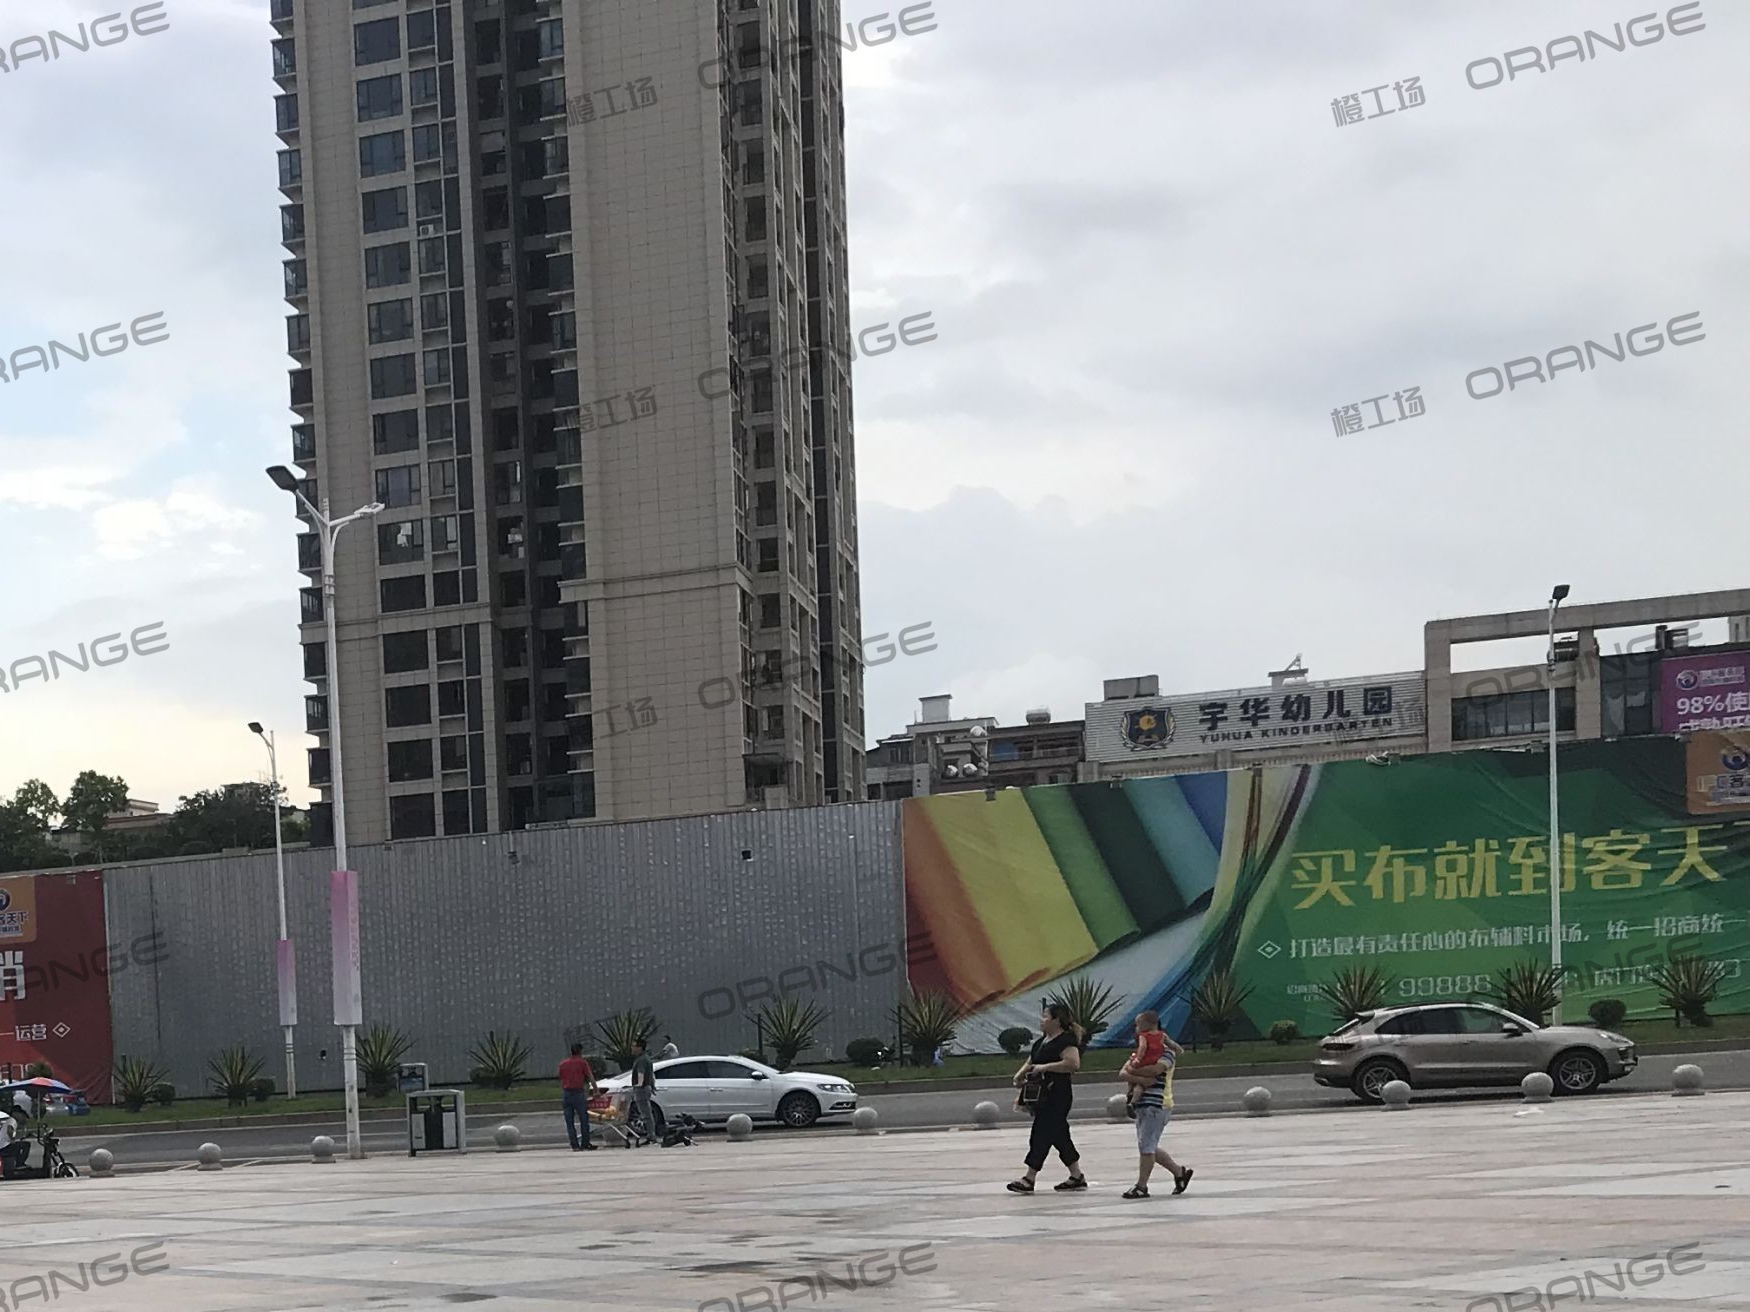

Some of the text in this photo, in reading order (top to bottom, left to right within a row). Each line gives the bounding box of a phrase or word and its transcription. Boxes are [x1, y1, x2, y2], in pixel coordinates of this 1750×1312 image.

[1199, 685, 1392, 731] 宇华幼儿园
[1200, 717, 1393, 744] YUHUA KINDERGARTEN
[1291, 822, 1750, 910] 买布就到客天
